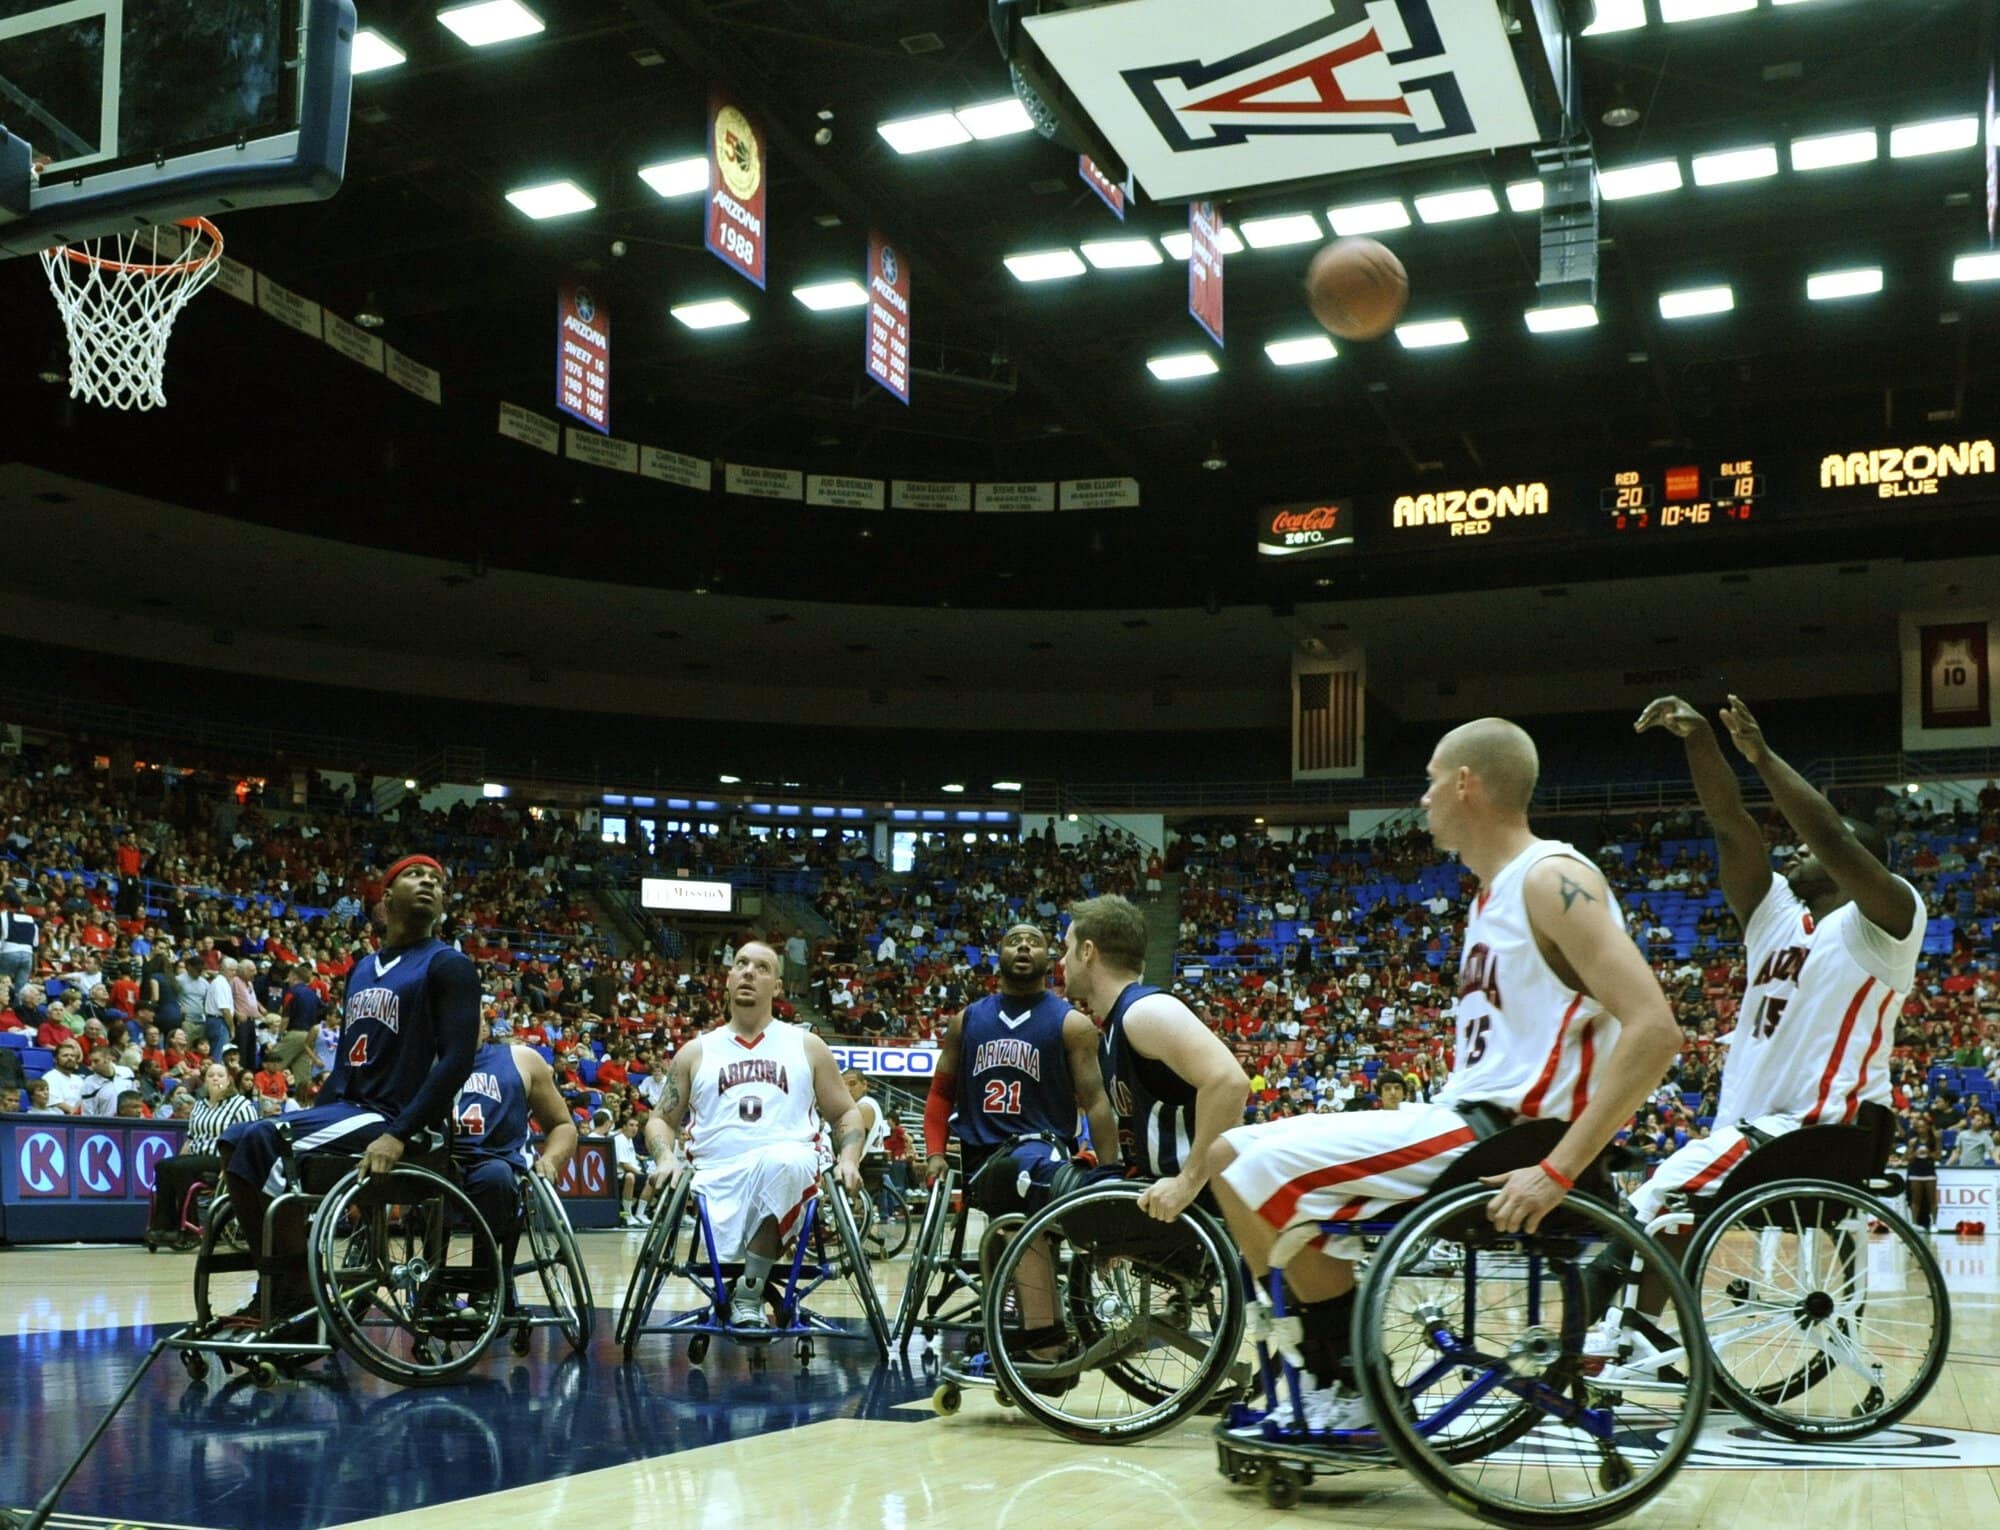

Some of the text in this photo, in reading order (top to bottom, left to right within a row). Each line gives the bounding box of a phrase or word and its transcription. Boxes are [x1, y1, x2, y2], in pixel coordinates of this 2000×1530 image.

[712, 190, 760, 237] ARIZONA
[719, 222, 754, 264] 1988
[872, 276, 907, 314] ARIZONA
[564, 315, 606, 350] ARIZONA
[873, 303, 896, 329] SWEET
[564, 340, 605, 373] SWEET 16
[1615, 472, 1639, 485] RED
[1720, 461, 1752, 476] BLUE
[1820, 439, 1995, 488] ARIZONA
[1616, 487, 1643, 508] 20
[1734, 477, 1754, 497] 18
[1878, 478, 1938, 498] BLUE
[1272, 505, 1338, 533] Coca-Cola
[1393, 482, 1548, 528] ARIZONA
[1661, 503, 1711, 526] 10:46
[1451, 520, 1491, 536] RED
[1944, 667, 1966, 686] 10
[344, 987, 399, 1034] ARIZONA
[1752, 995, 1788, 1040] 15
[348, 1033, 368, 1067] 4
[831, 1049, 933, 1073] GEICO
[972, 1038, 1040, 1083] ARIZONA
[718, 1059, 789, 1097] ARIZONA
[739, 1095, 762, 1122] 0
[983, 1079, 1021, 1115] 21
